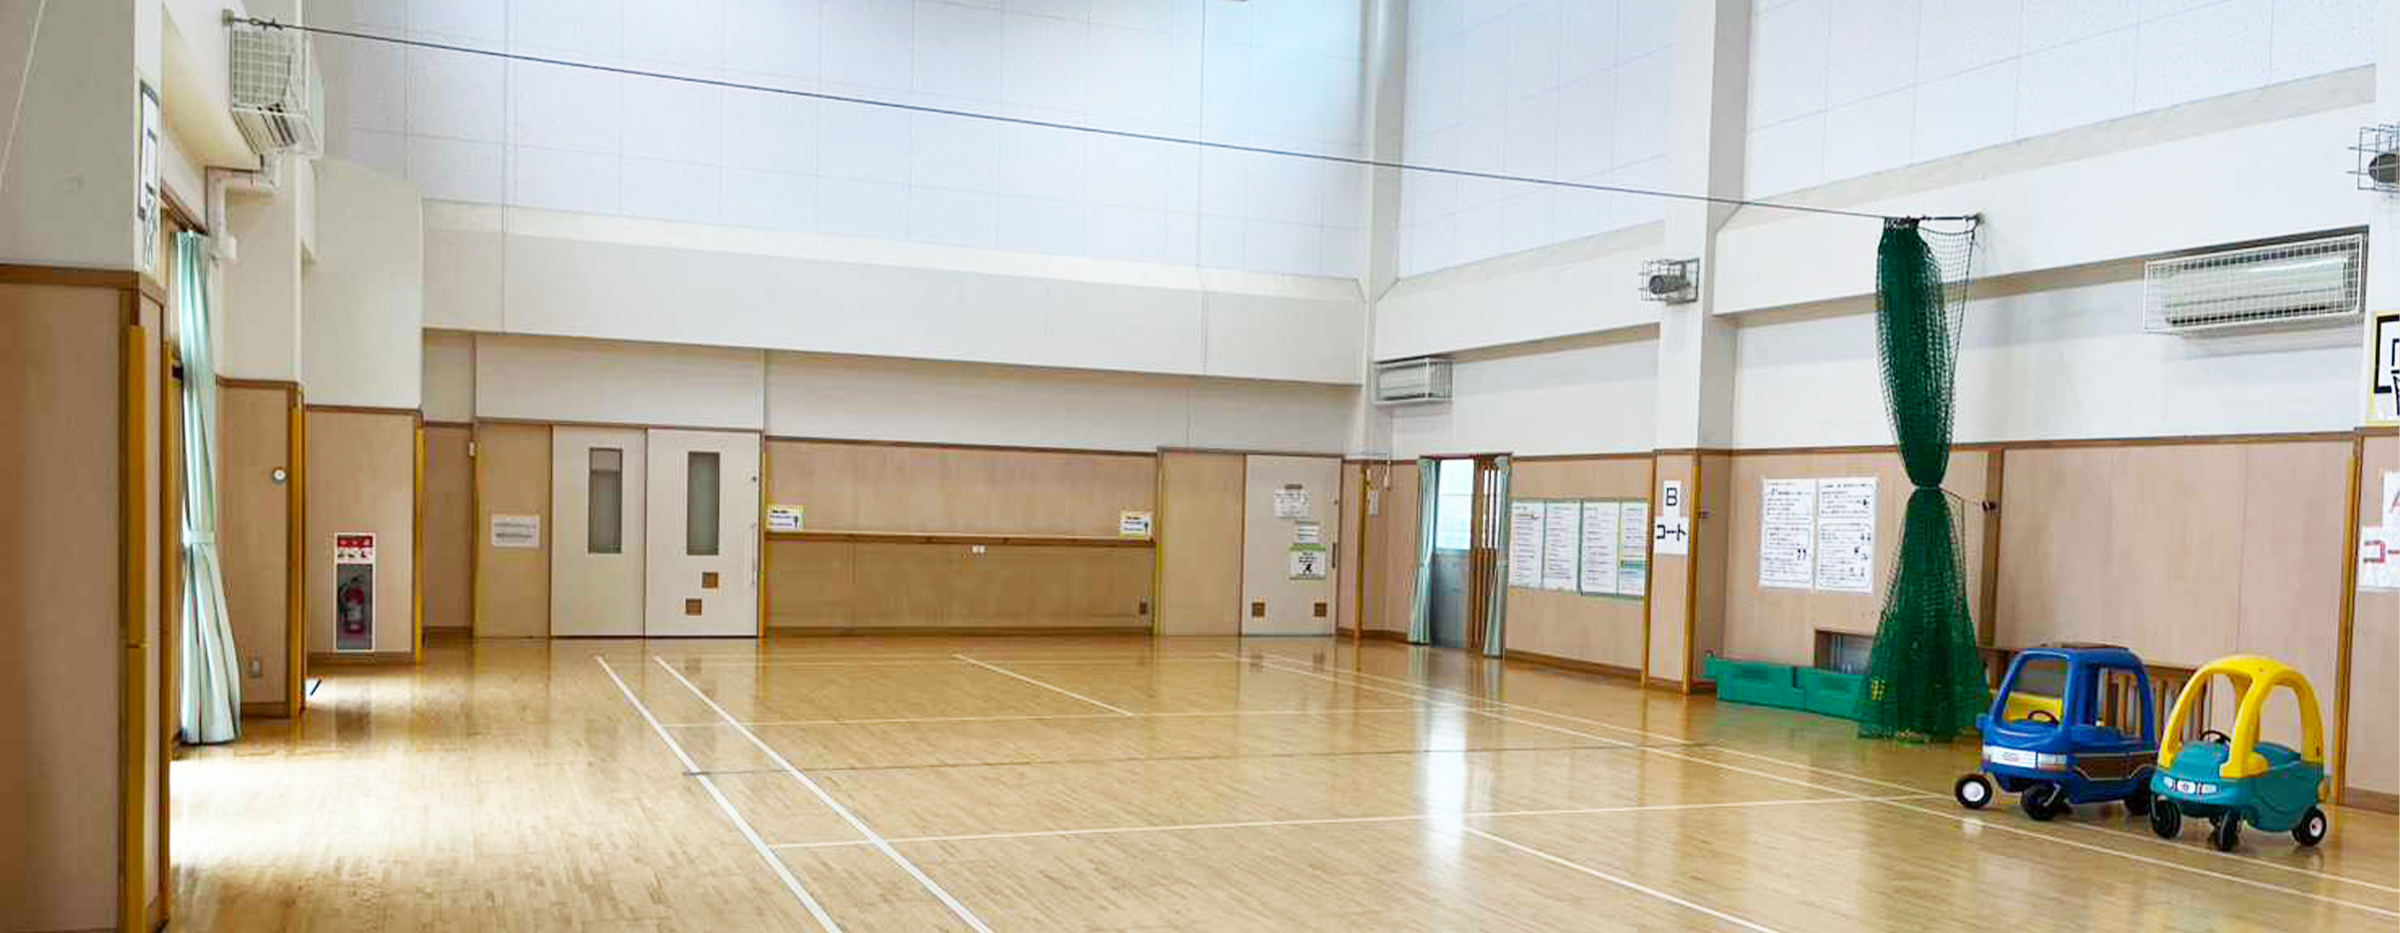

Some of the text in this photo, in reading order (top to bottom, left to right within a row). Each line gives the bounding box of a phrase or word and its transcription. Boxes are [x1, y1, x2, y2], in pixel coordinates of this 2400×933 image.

[1666, 487, 1677, 506] B
[1657, 524, 1686, 541] コート
